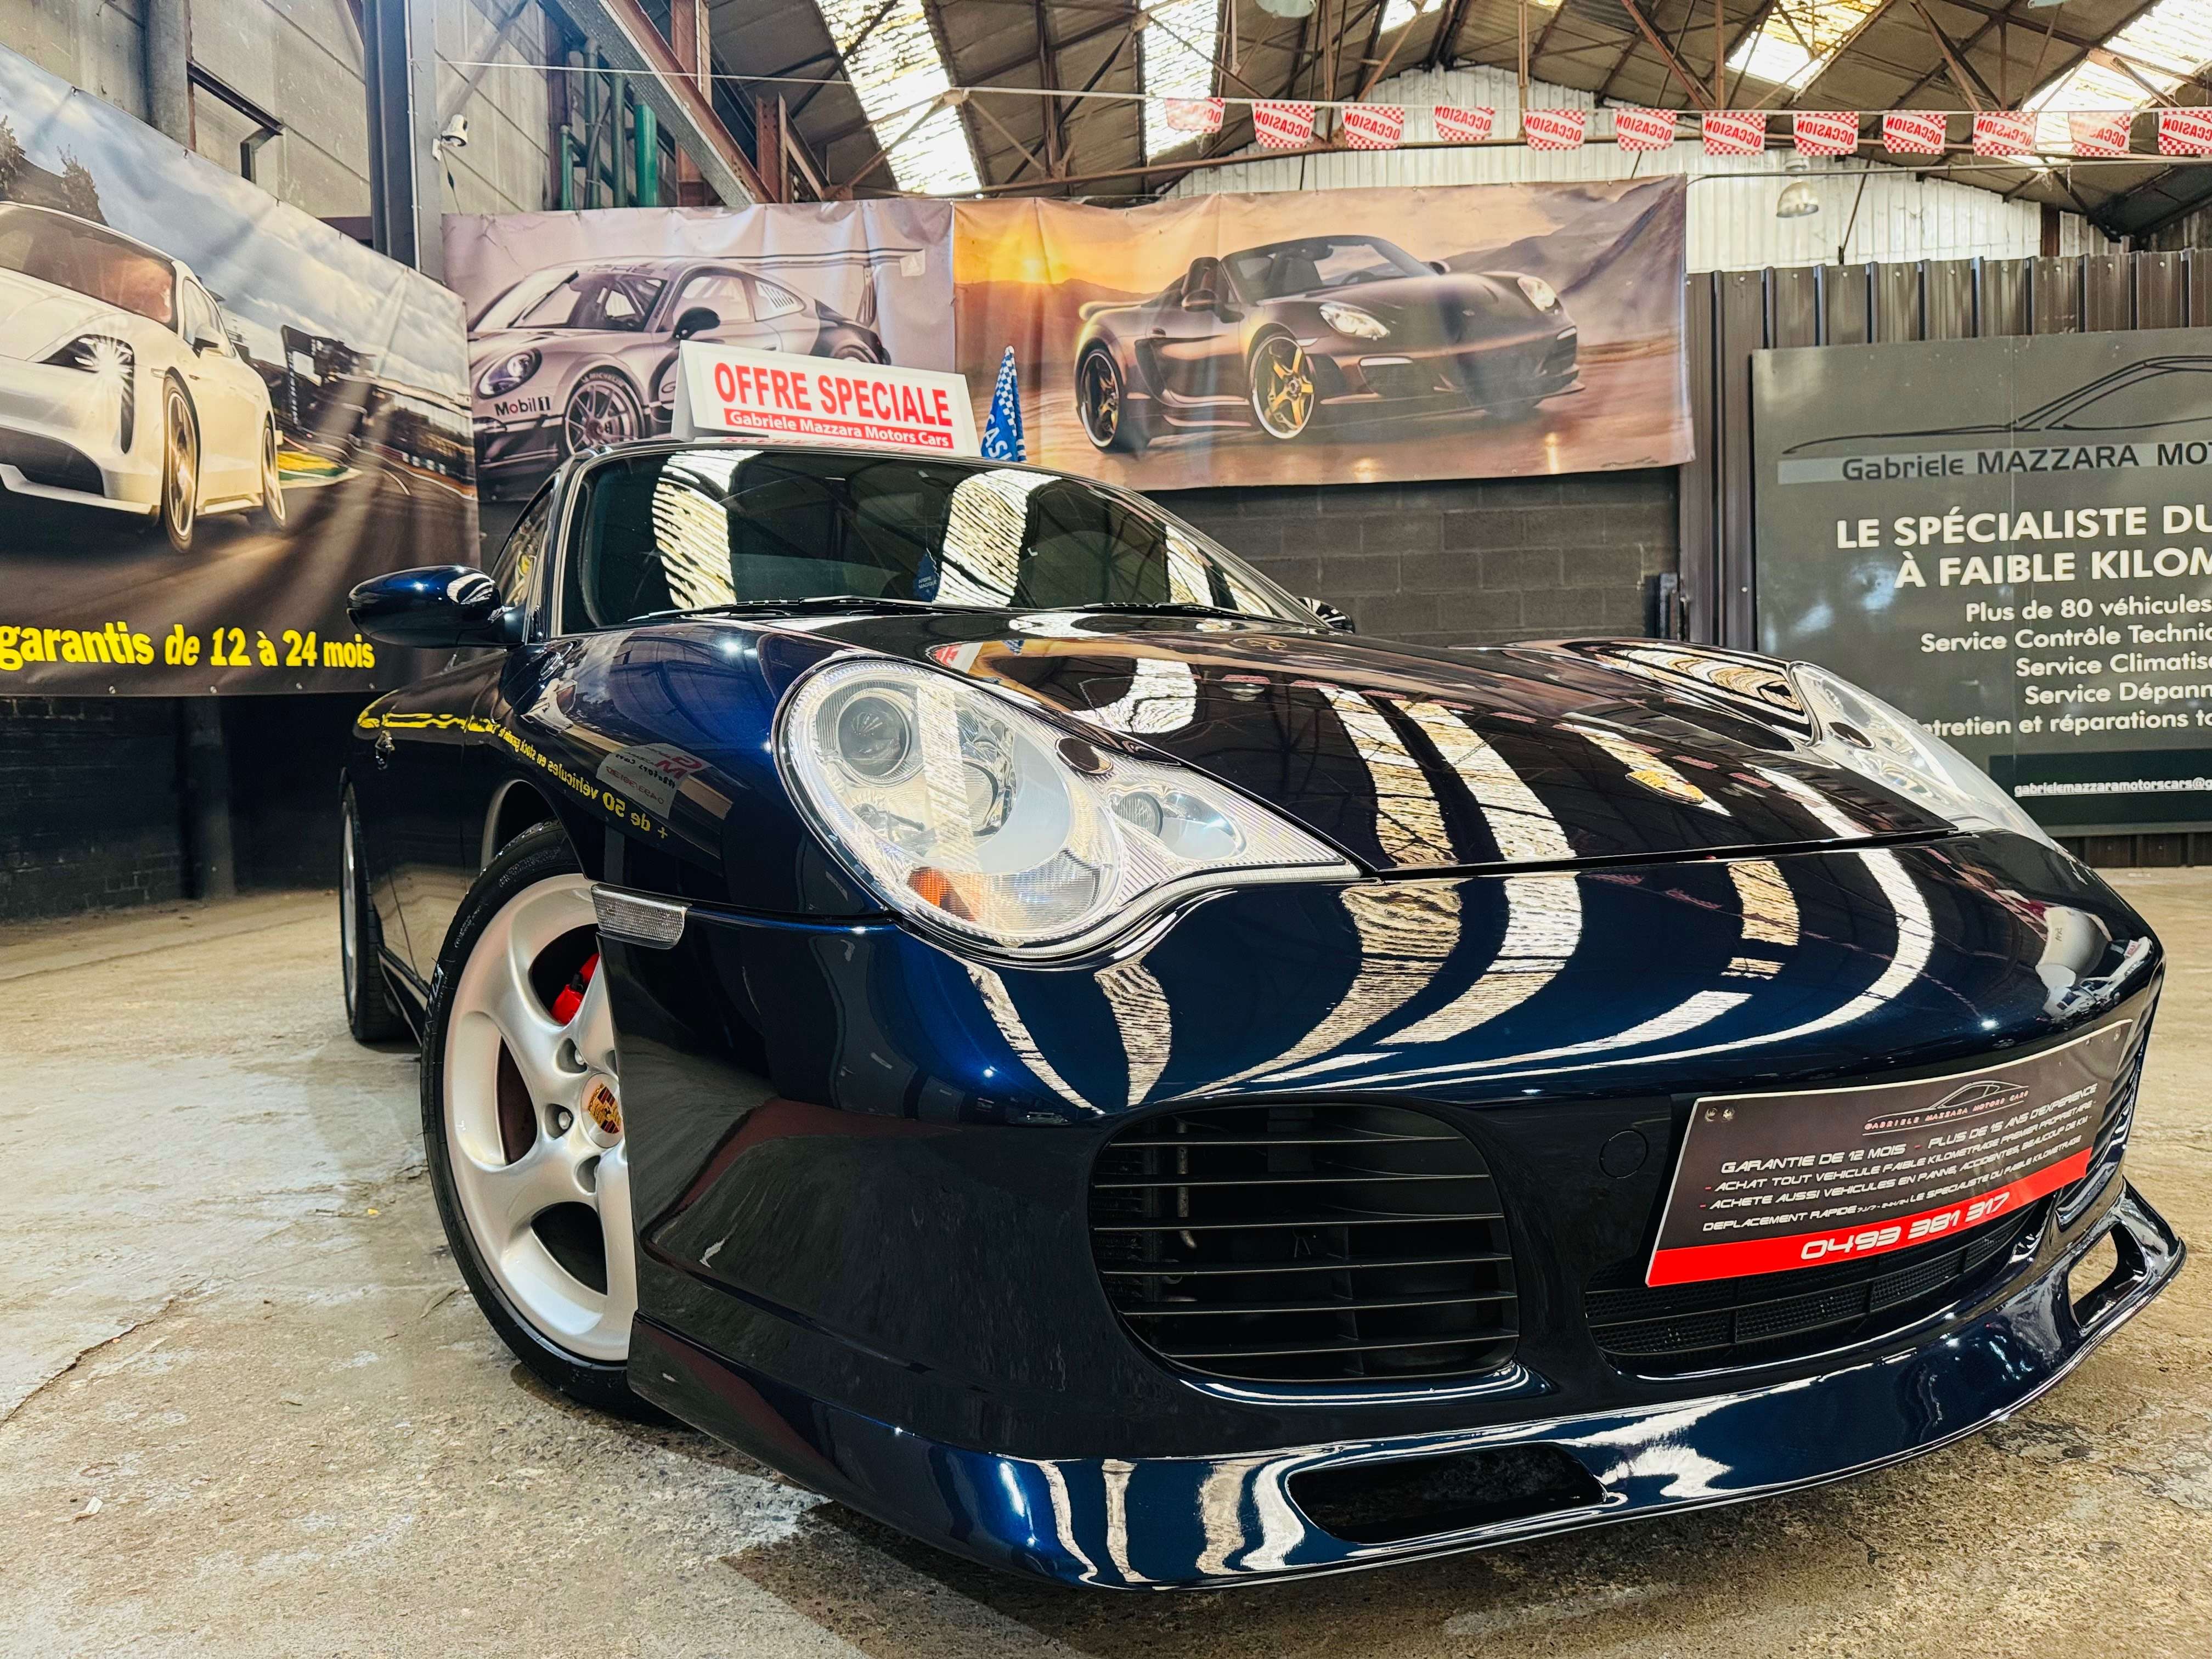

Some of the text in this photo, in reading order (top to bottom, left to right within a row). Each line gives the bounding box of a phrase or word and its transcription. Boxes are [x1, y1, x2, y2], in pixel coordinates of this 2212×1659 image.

[495, 397, 536, 416] Mobil
[714, 362, 953, 427] OFFRE SPECIALE
[730, 410, 797, 432] Gabriele
[800, 419, 862, 438] Mazzara
[865, 426, 915, 444] Motors
[918, 431, 949, 447] Cars
[1842, 442, 2212, 481] Gabriele MAZZARA MO
[1837, 519, 1880, 549] LE
[1894, 506, 2147, 546] SPÉCIALISTE
[1894, 553, 1926, 589] À
[1939, 552, 2076, 586] FAIBLE
[1966, 594, 2212, 622] Plus de 80 véhicules
[0, 622, 375, 670] garantis de 12 à 24 mois
[1921, 633, 2006, 653] Service
[2015, 626, 2121, 648] Contrôle
[2016, 651, 2212, 676] Service Climatis
[2025, 681, 2212, 705] Service Dépann
[1912, 717, 2011, 737] ntretien
[2019, 717, 2042, 733] et
[2050, 710, 2188, 736] réparations
[1864, 1116, 1920, 1130] GABRIELE
[1714, 1179, 1768, 1192] ACHAT
[1771, 1174, 1812, 1186] TOUT
[1815, 1165, 1881, 1182] VEHICULE
[1882, 1157, 1926, 1173] FAIBLE
[1927, 1137, 1999, 1165] KILOMETRAGE
[2000, 1123, 2039, 1144] PREMIER
[1721, 1154, 1815, 1173] GARANTIE
[1818, 1152, 1845, 1165] DE
[1848, 1149, 1865, 1162] 12
[1867, 1143, 1907, 1160] MOIS
[1927, 1131, 1967, 1149] PLUS
[1968, 1126, 1989, 1140] DE
[1990, 1121, 2004, 1133] 15
[2004, 1112, 2029, 1129] ANS
[1709, 1195, 1773, 1210] ACHETE
[1775, 1189, 1820, 1203] AUSSI
[1824, 1178, 1897, 1198] VEHICULES
[1898, 1175, 1916, 1186] EN
[2021, 1126, 2065, 1150] BEAUCOUP
[2064, 1120, 2077, 1132] DE
[2076, 1115, 2089, 1126] KM
[1702, 1212, 1807, 1231] DEPLACEMENT
[1809, 1205, 1858, 1220] RAPIDE
[1910, 1192, 1925, 1202] LE
[1926, 1173, 1990, 1198] SPECIALISTE
[1990, 1168, 2004, 1180] DU
[2004, 1156, 2033, 1175] FAIBLE
[2033, 1135, 2082, 1163] KILOMETRAGE
[1800, 1191, 2010, 1260] 0493 381 317
